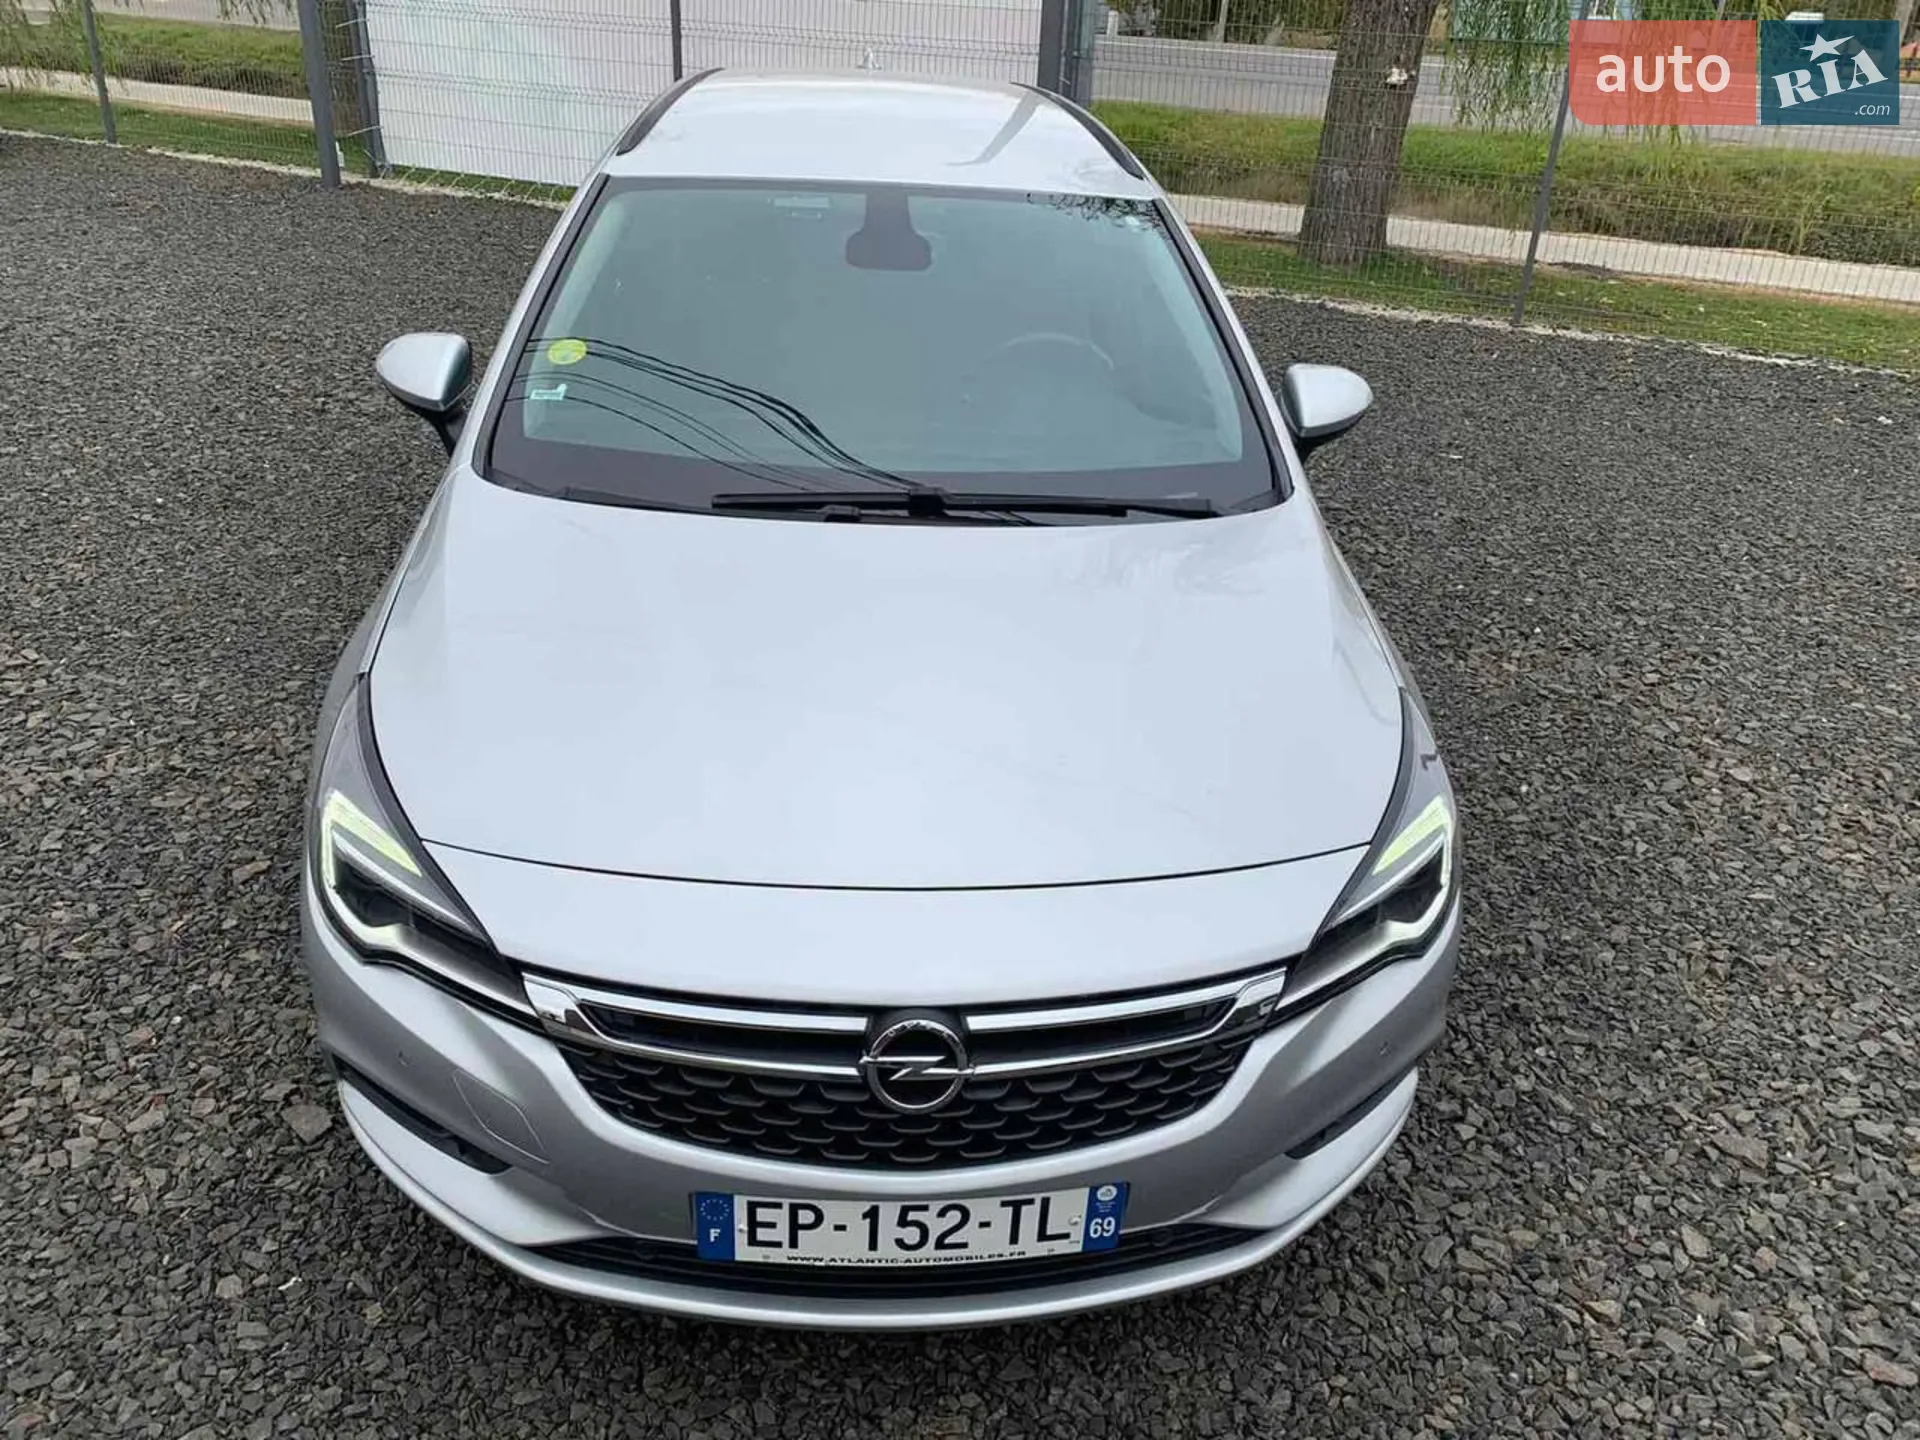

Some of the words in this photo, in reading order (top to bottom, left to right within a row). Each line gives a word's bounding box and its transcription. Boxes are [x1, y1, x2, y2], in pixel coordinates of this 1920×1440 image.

[709, 1228, 721, 1242] F
[746, 1196, 1071, 1252] EP-152-TL
[1089, 1216, 1116, 1238] 69
